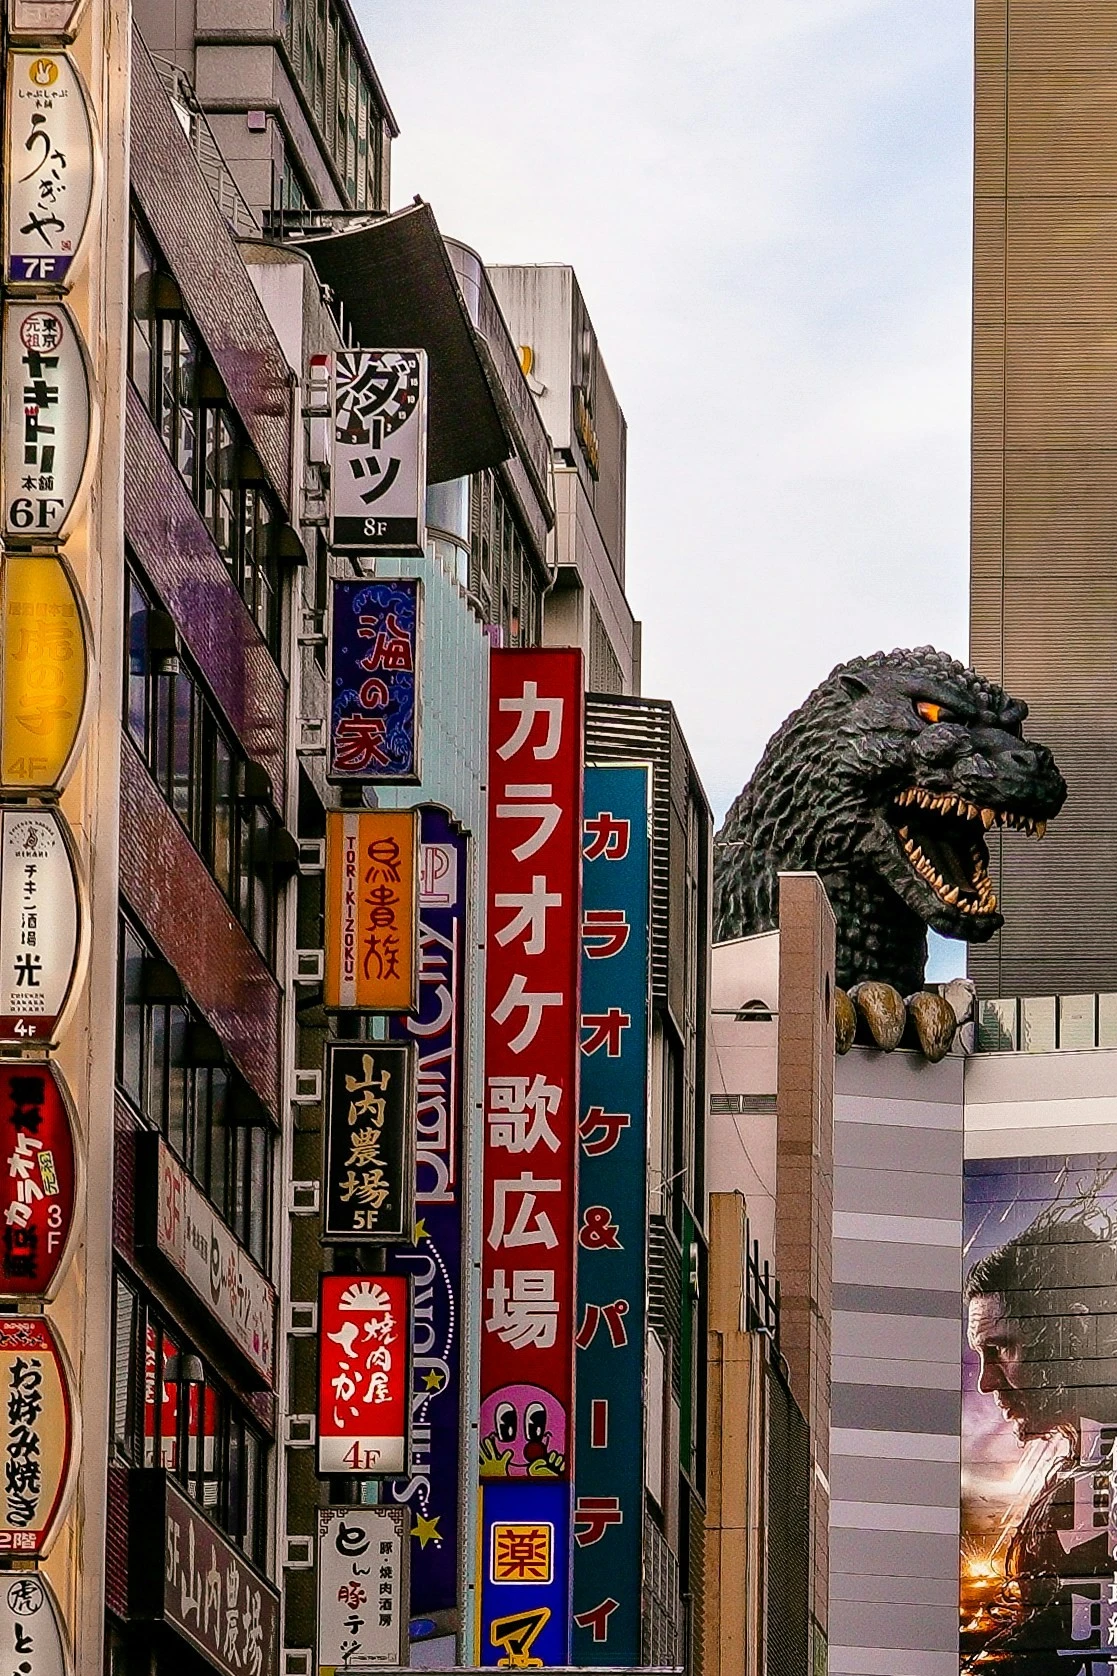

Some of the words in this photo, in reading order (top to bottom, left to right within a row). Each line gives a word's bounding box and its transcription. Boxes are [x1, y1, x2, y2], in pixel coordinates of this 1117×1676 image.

[18, 113, 66, 250] うさぎや
[23, 258, 55, 279] 7F
[22, 351, 60, 474] ヤキトリ
[350, 362, 402, 505] ダーツ
[9, 499, 64, 528] 6F
[21, 475, 55, 491] 本舗
[363, 518, 388, 537] 8F
[334, 612, 414, 770] 海の家
[7, 757, 49, 780] 4F
[22, 864, 38, 948] チキン酒場
[345, 836, 357, 973] TORIKIZOKU
[365, 837, 402, 981] 鳥貴族
[14, 953, 42, 987] 光
[14, 1019, 37, 1037] 4F
[489, 680, 566, 1351] カラオケ歌広場
[341, 1054, 391, 1209] 山内農場
[47, 1204, 62, 1254] 3F
[352, 1211, 379, 1230] 5F
[326, 1320, 364, 1429] さかい
[362, 1315, 398, 1405] 焼肉屋
[5, 1357, 44, 1527] お好み焼き
[341, 1443, 381, 1470] 4F
[497, 1530, 546, 1578] 薬
